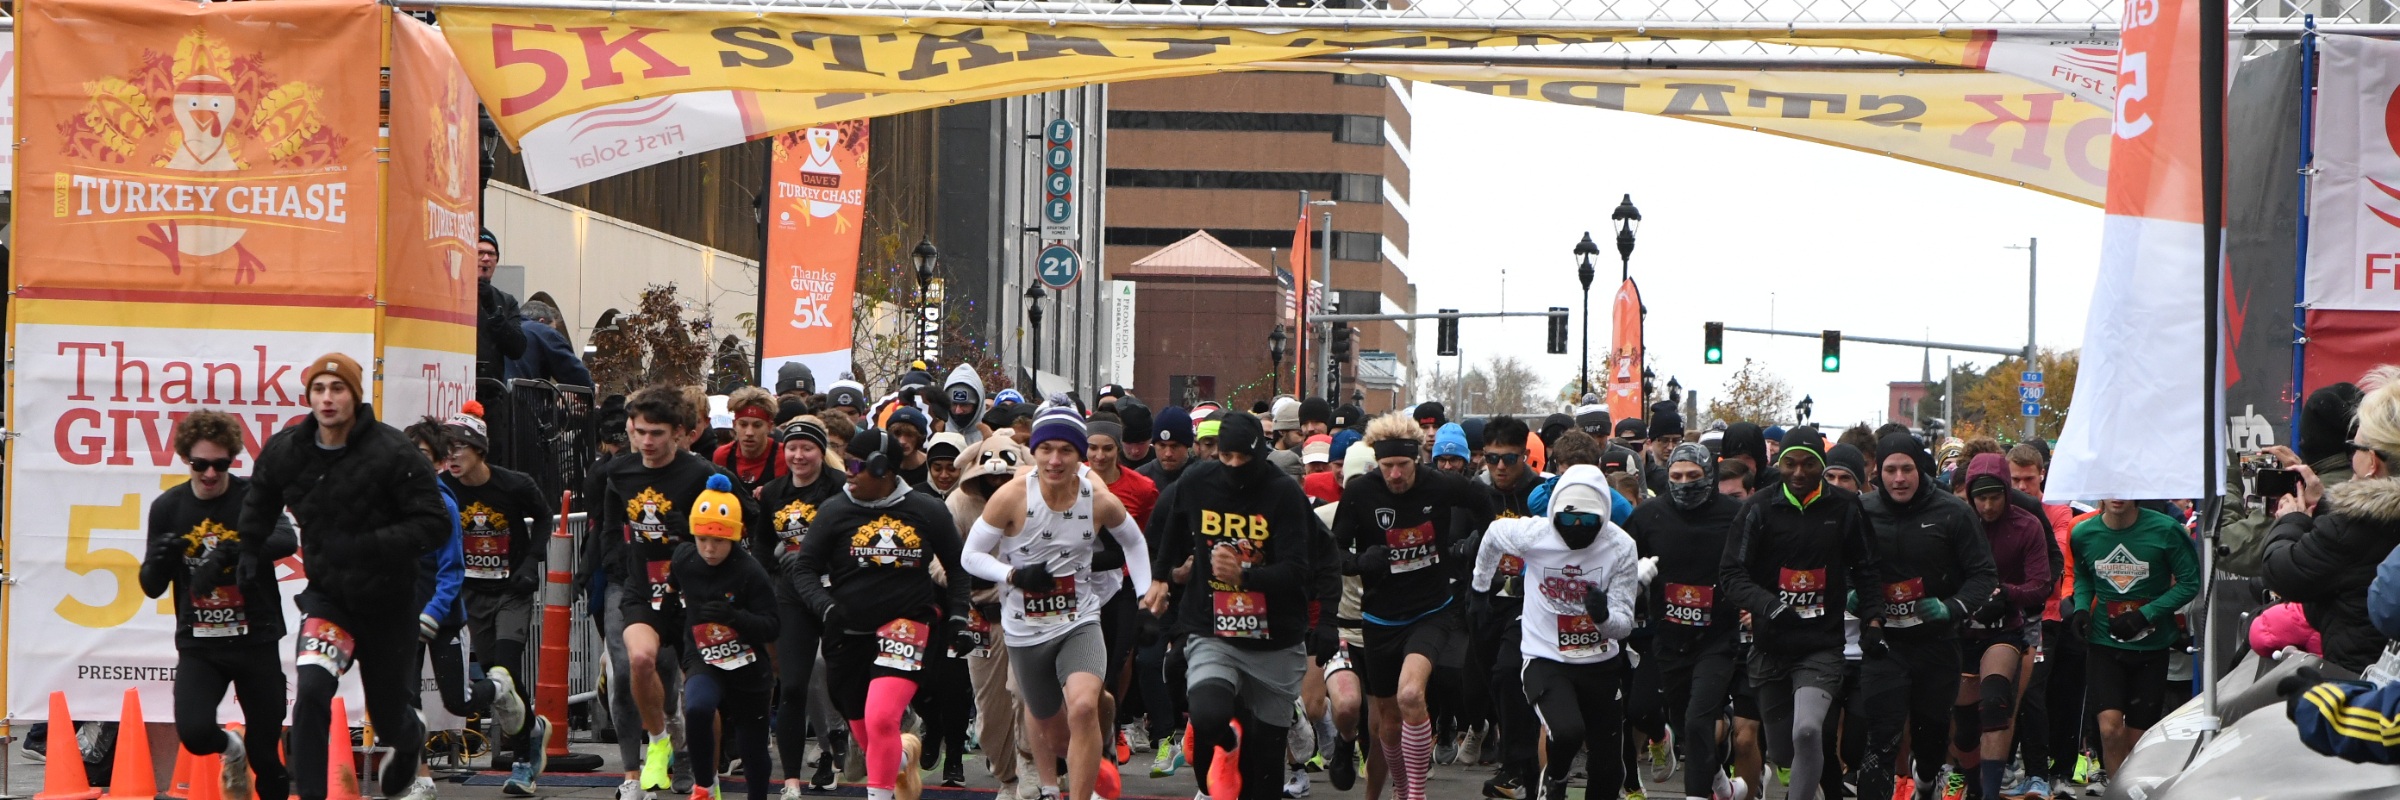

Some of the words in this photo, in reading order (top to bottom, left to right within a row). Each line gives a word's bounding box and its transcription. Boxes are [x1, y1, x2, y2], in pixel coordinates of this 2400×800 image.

[492, 23, 691, 117] 5K
[2051, 65, 2104, 95] First
[1053, 124, 1065, 217] EDGE
[803, 174, 837, 186] DAVE'S
[73, 174, 219, 216] TURKEY
[226, 182, 346, 223] CHASE
[778, 181, 819, 200] TURKEY
[822, 189, 862, 206] CHASE
[791, 265, 837, 282] Thanks
[1043, 256, 1073, 276] 21
[790, 279, 834, 293] GIVING
[815, 292, 831, 300] DAY
[1122, 298, 1130, 358] PROMEDICA
[423, 363, 476, 421] Thank
[2023, 387, 2040, 398] 280
[1201, 509, 1269, 540] BRB
[54, 491, 148, 628] 5
[466, 554, 500, 567] 3200
[855, 547, 890, 556] TURKEY
[892, 549, 922, 558] CHASE
[1390, 544, 1428, 561] 3774
[1538, 583, 1586, 604] COUNT
[1780, 590, 1816, 605] 2747
[1026, 595, 1067, 611] 4118
[1666, 603, 1702, 621] 2496
[1884, 600, 1917, 615] 2687
[193, 608, 235, 623] 1292
[1216, 615, 1258, 631] 3249
[1560, 631, 1599, 646] 3863
[305, 637, 338, 659] 310
[701, 640, 741, 660] 2565
[877, 638, 915, 658] 1290
